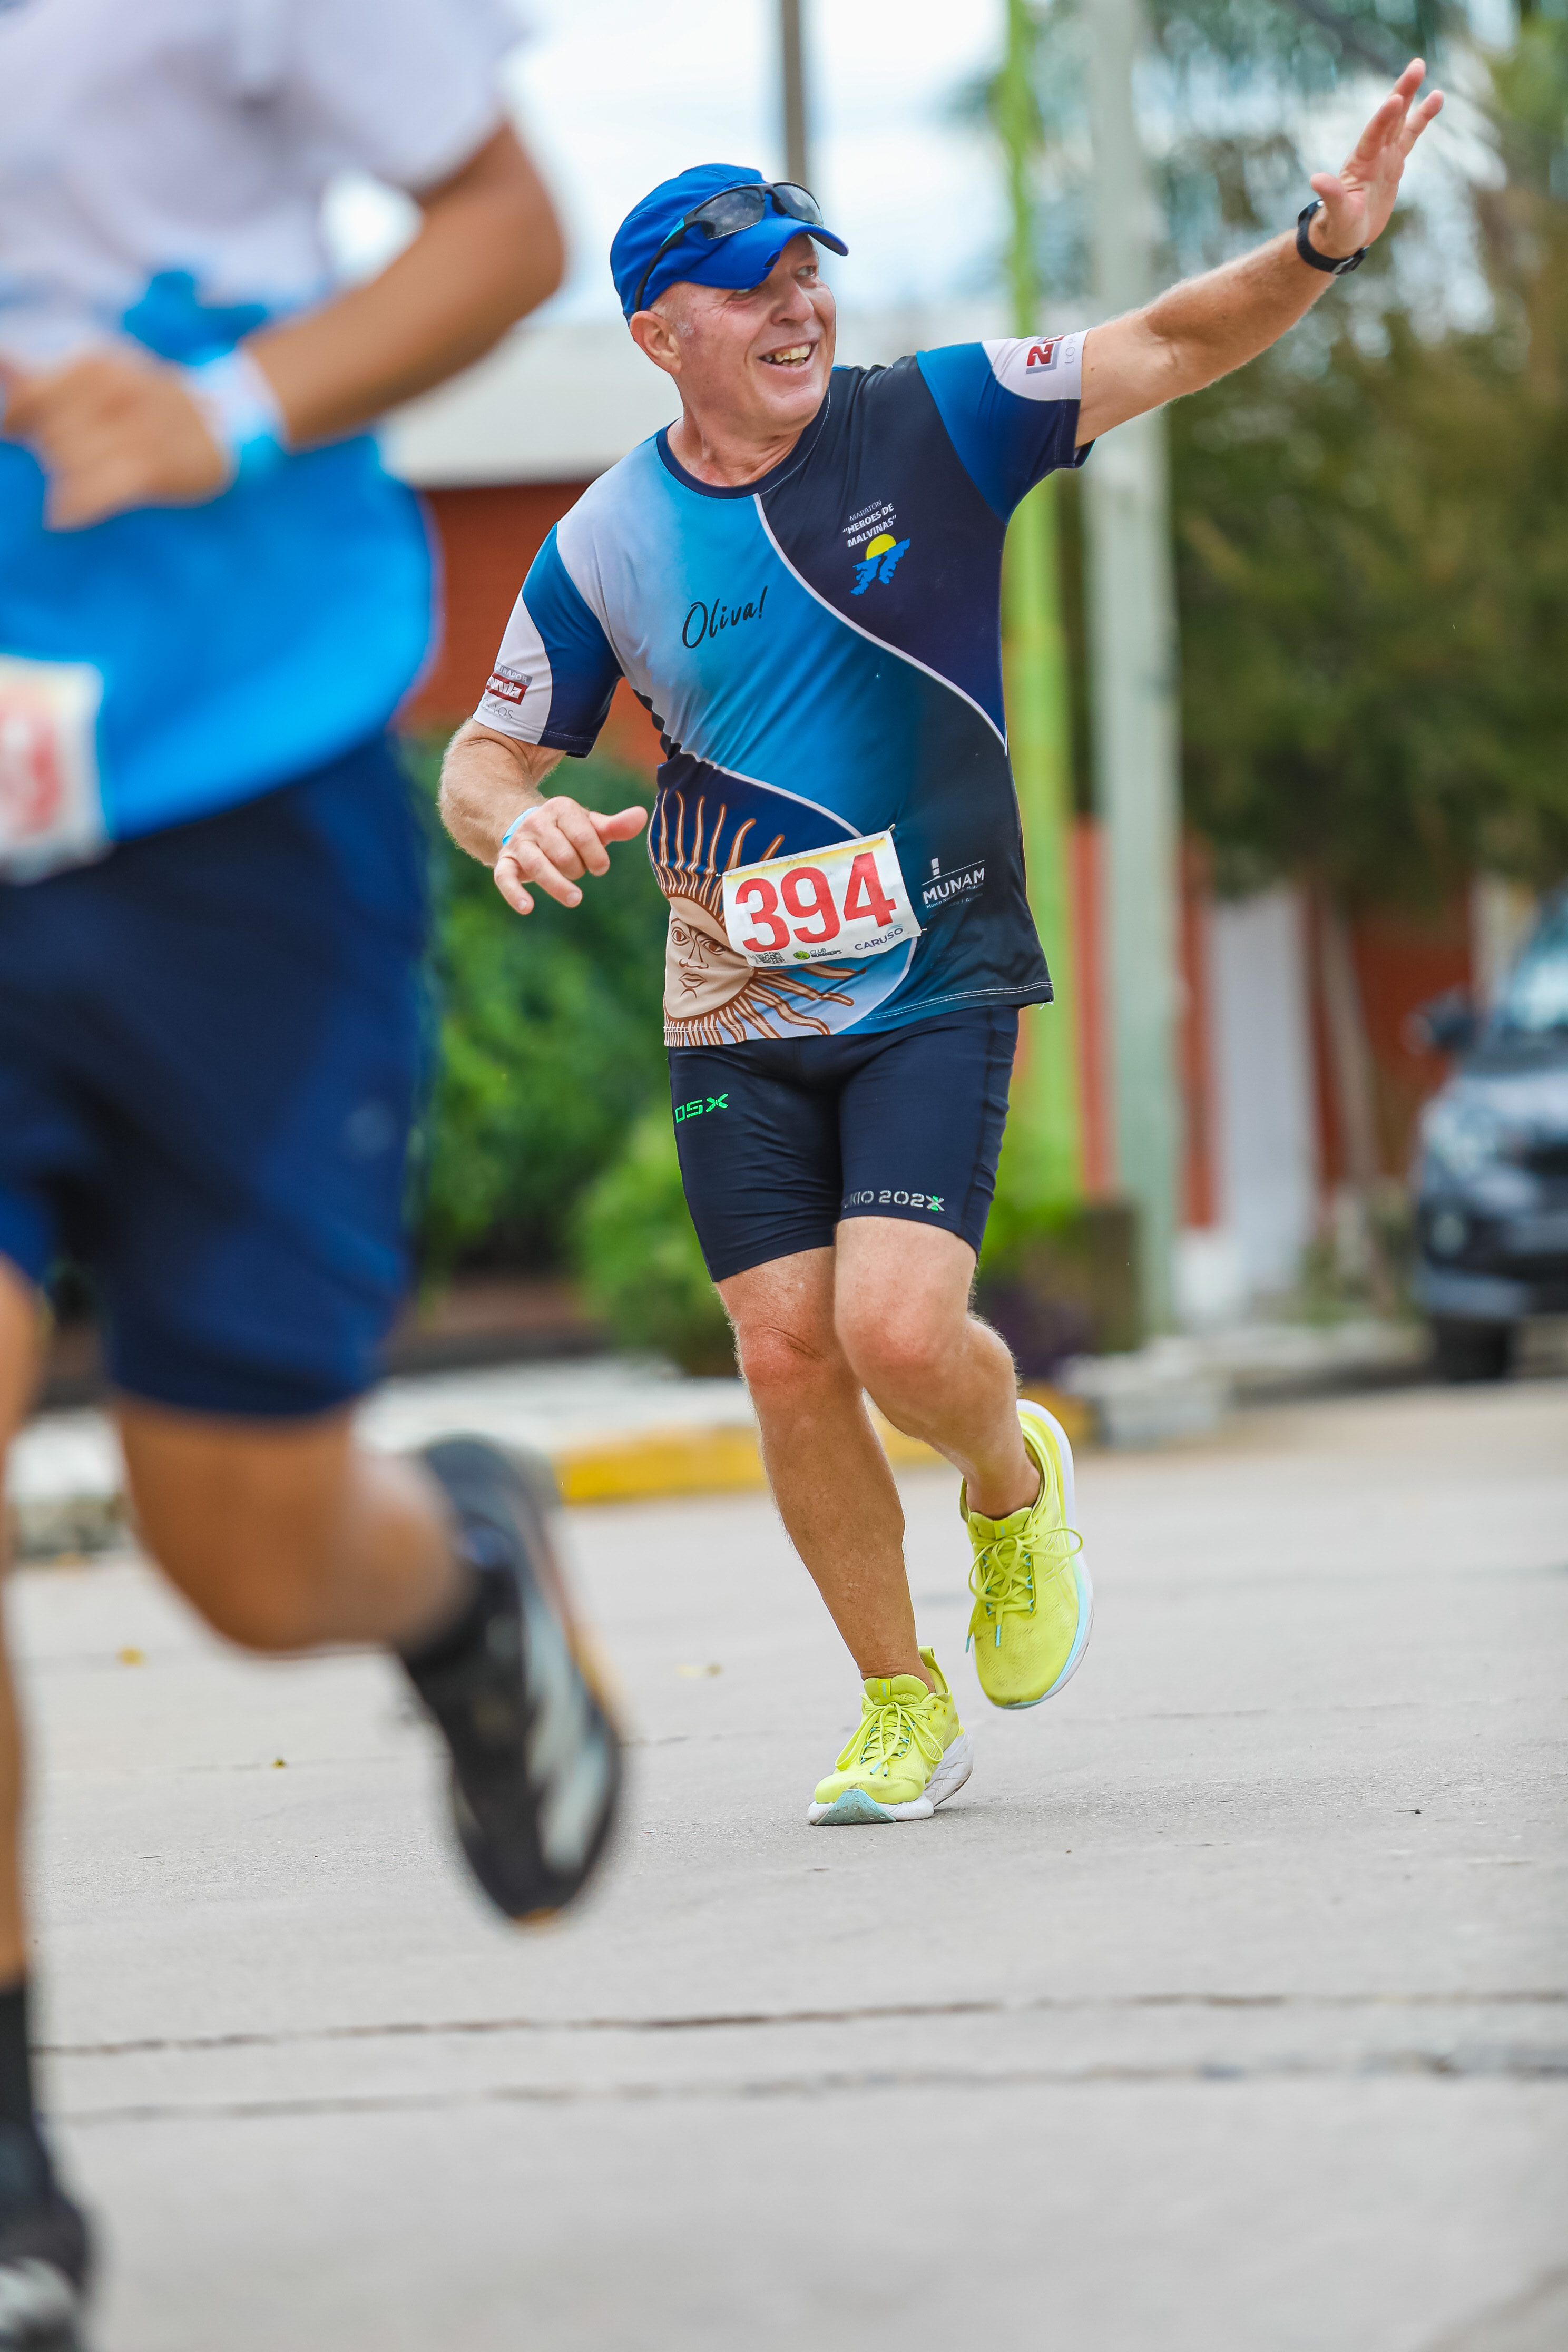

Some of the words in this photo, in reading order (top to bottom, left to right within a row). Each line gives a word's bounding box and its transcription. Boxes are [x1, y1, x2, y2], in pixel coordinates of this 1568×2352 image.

[842, 511, 881, 534] "HEROES
[881, 503, 894, 516] DE
[849, 499, 882, 522] MARATON
[847, 514, 896, 548] MALVINAS"
[682, 585, 768, 649] Oliva!
[735, 851, 897, 952] 394
[922, 867, 985, 905] MUNAM
[855, 927, 904, 951] CARUSO
[879, 1189, 946, 1212] 202X
